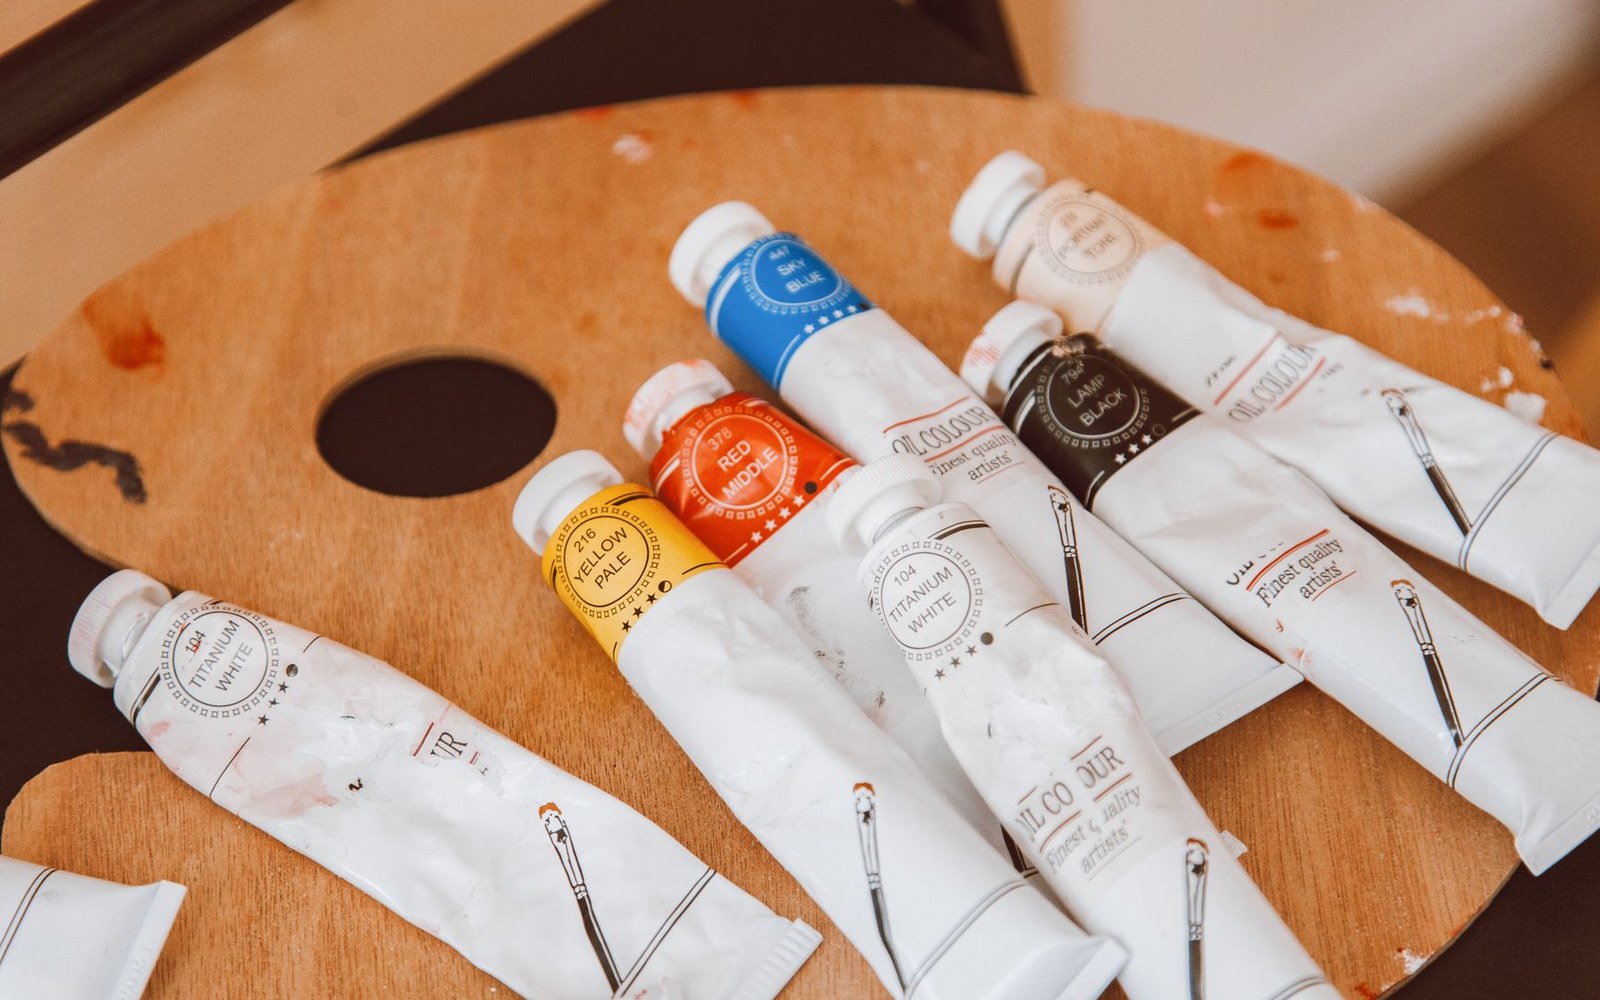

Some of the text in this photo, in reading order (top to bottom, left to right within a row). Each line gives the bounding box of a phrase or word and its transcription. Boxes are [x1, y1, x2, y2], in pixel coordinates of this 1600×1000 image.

[777, 258, 807, 276] SKY
[786, 271, 826, 293] BLUE
[1061, 364, 1084, 385] 794
[1066, 375, 1105, 408] LAMP
[1080, 389, 1128, 428] BLACK
[1228, 399, 1266, 422] OIL
[707, 427, 733, 451] 378
[919, 406, 997, 449] COLOUR
[717, 440, 751, 471] RED
[971, 433, 1018, 457] quality
[721, 447, 779, 499] MIDDLE
[968, 450, 1012, 481] artists'
[573, 528, 597, 553] 216
[574, 527, 628, 585] YELLOW
[594, 551, 631, 589] PALE
[894, 565, 917, 587] 104
[1256, 564, 1300, 608] Finest
[1298, 540, 1343, 570] quality
[1300, 560, 1342, 599] artists'
[889, 566, 953, 623] TITANIUM
[907, 592, 957, 634] WHITE
[185, 630, 206, 654] 104
[188, 620, 240, 688] TITANIUM
[215, 642, 253, 693] WHITE
